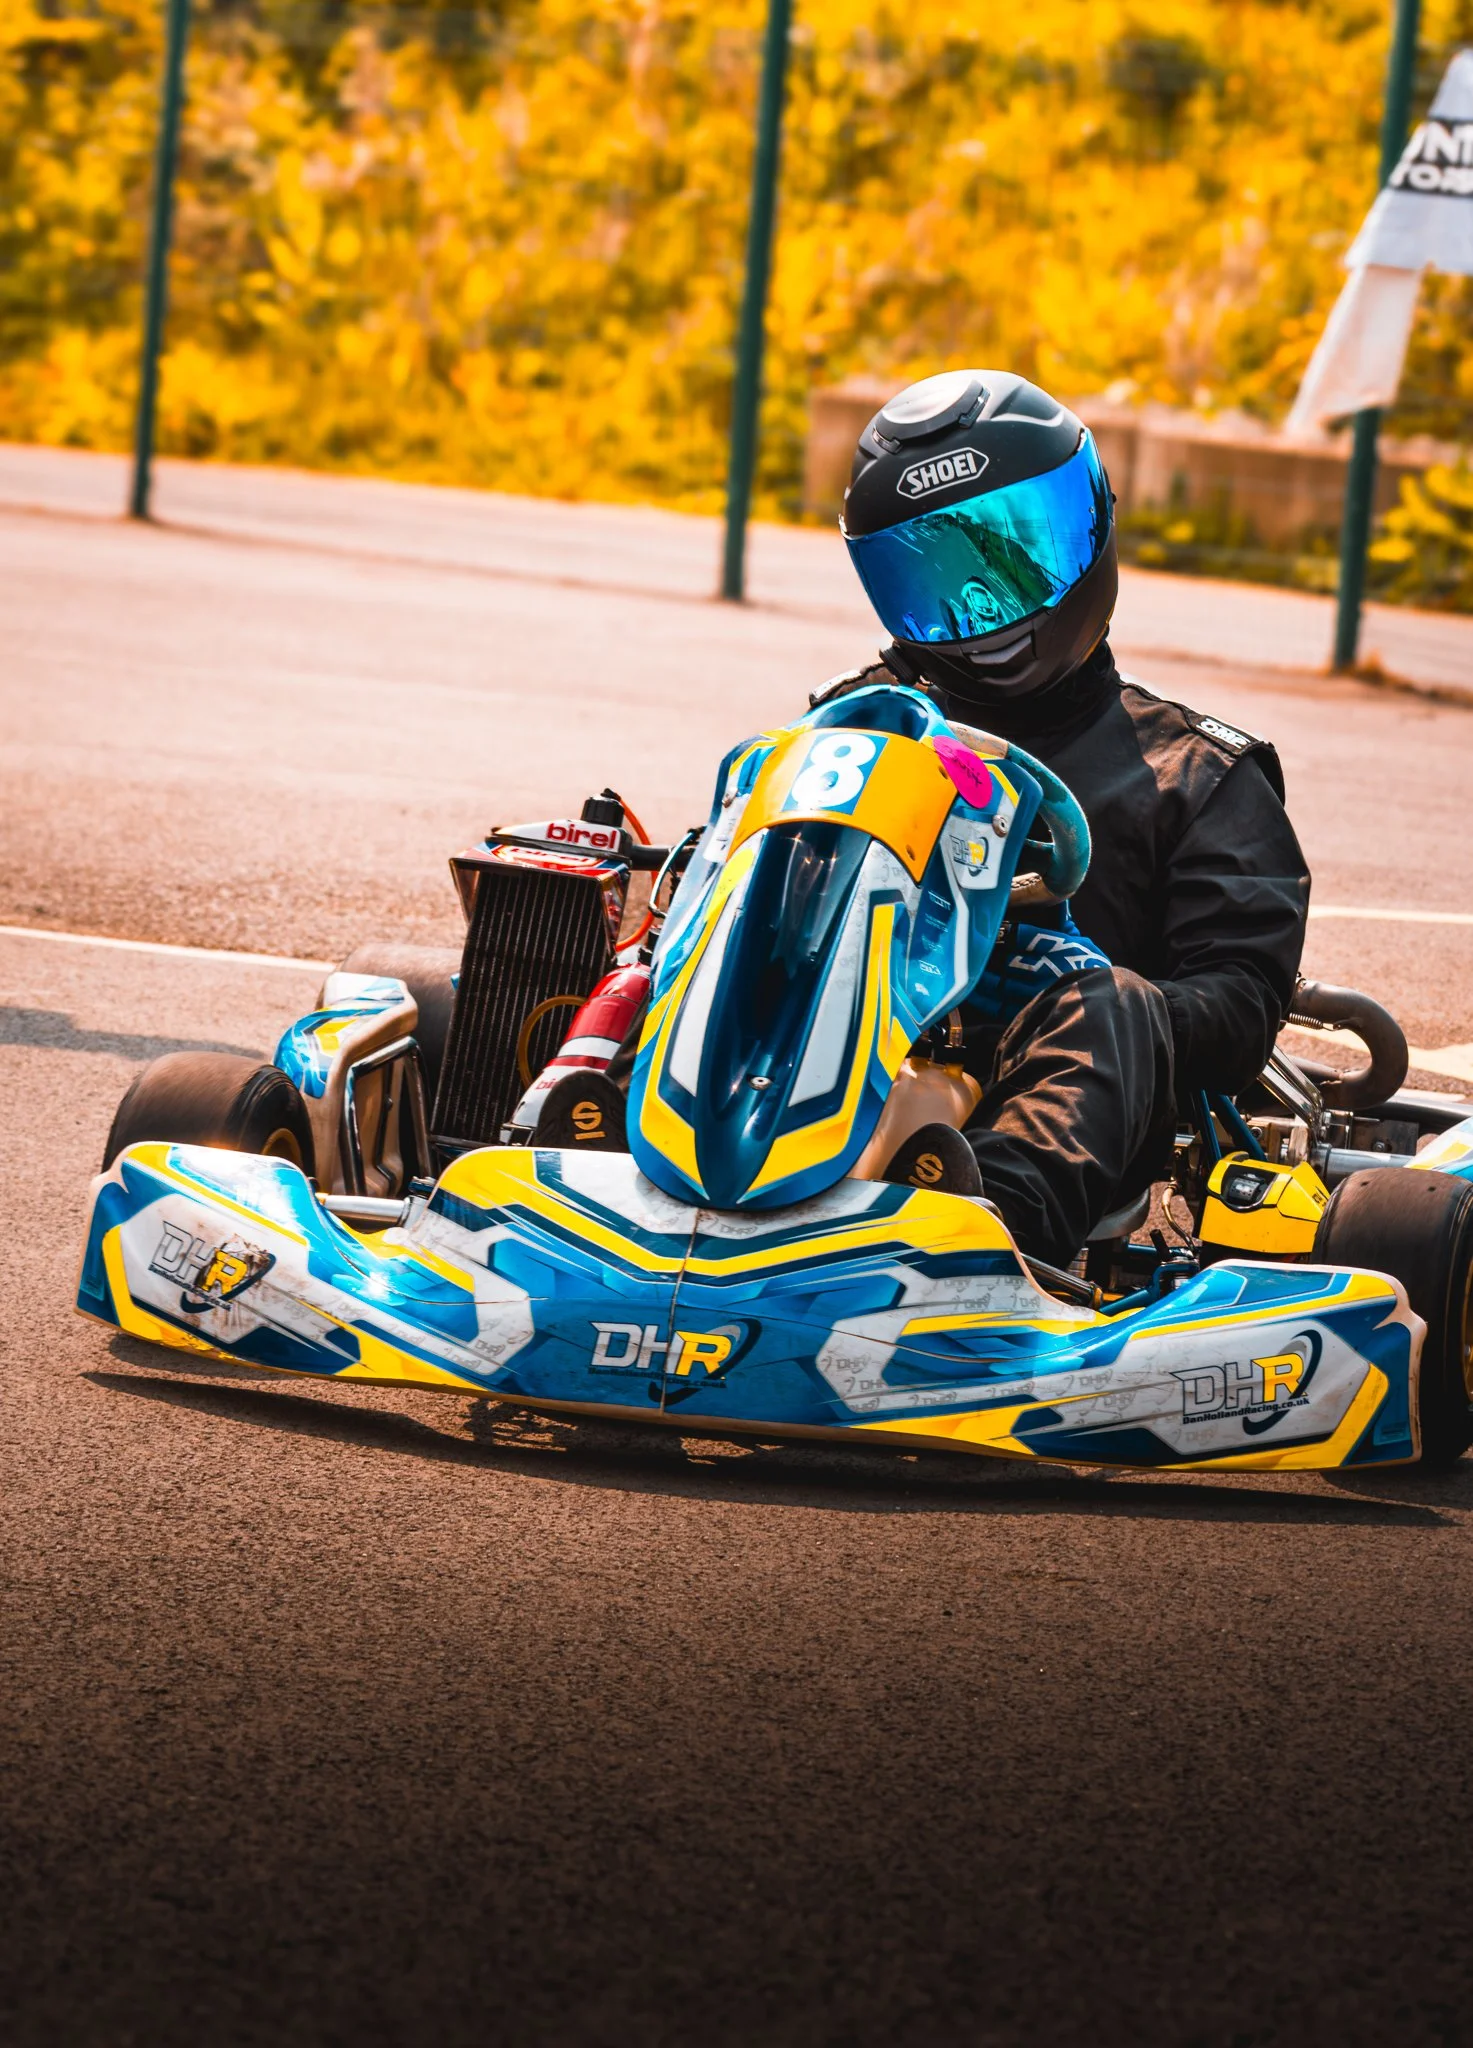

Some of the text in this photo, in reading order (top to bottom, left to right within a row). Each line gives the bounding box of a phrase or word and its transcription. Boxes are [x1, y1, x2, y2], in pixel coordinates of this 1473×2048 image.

[906, 452, 977, 494] SHOEI
[791, 733, 876, 808] 8
[546, 823, 617, 849] birel
[152, 1220, 249, 1295] DHR
[588, 1321, 732, 1377] DHR
[1169, 1352, 1309, 1417] DHR
[1182, 1397, 1310, 1425] DanHollandRacing.co.uk
